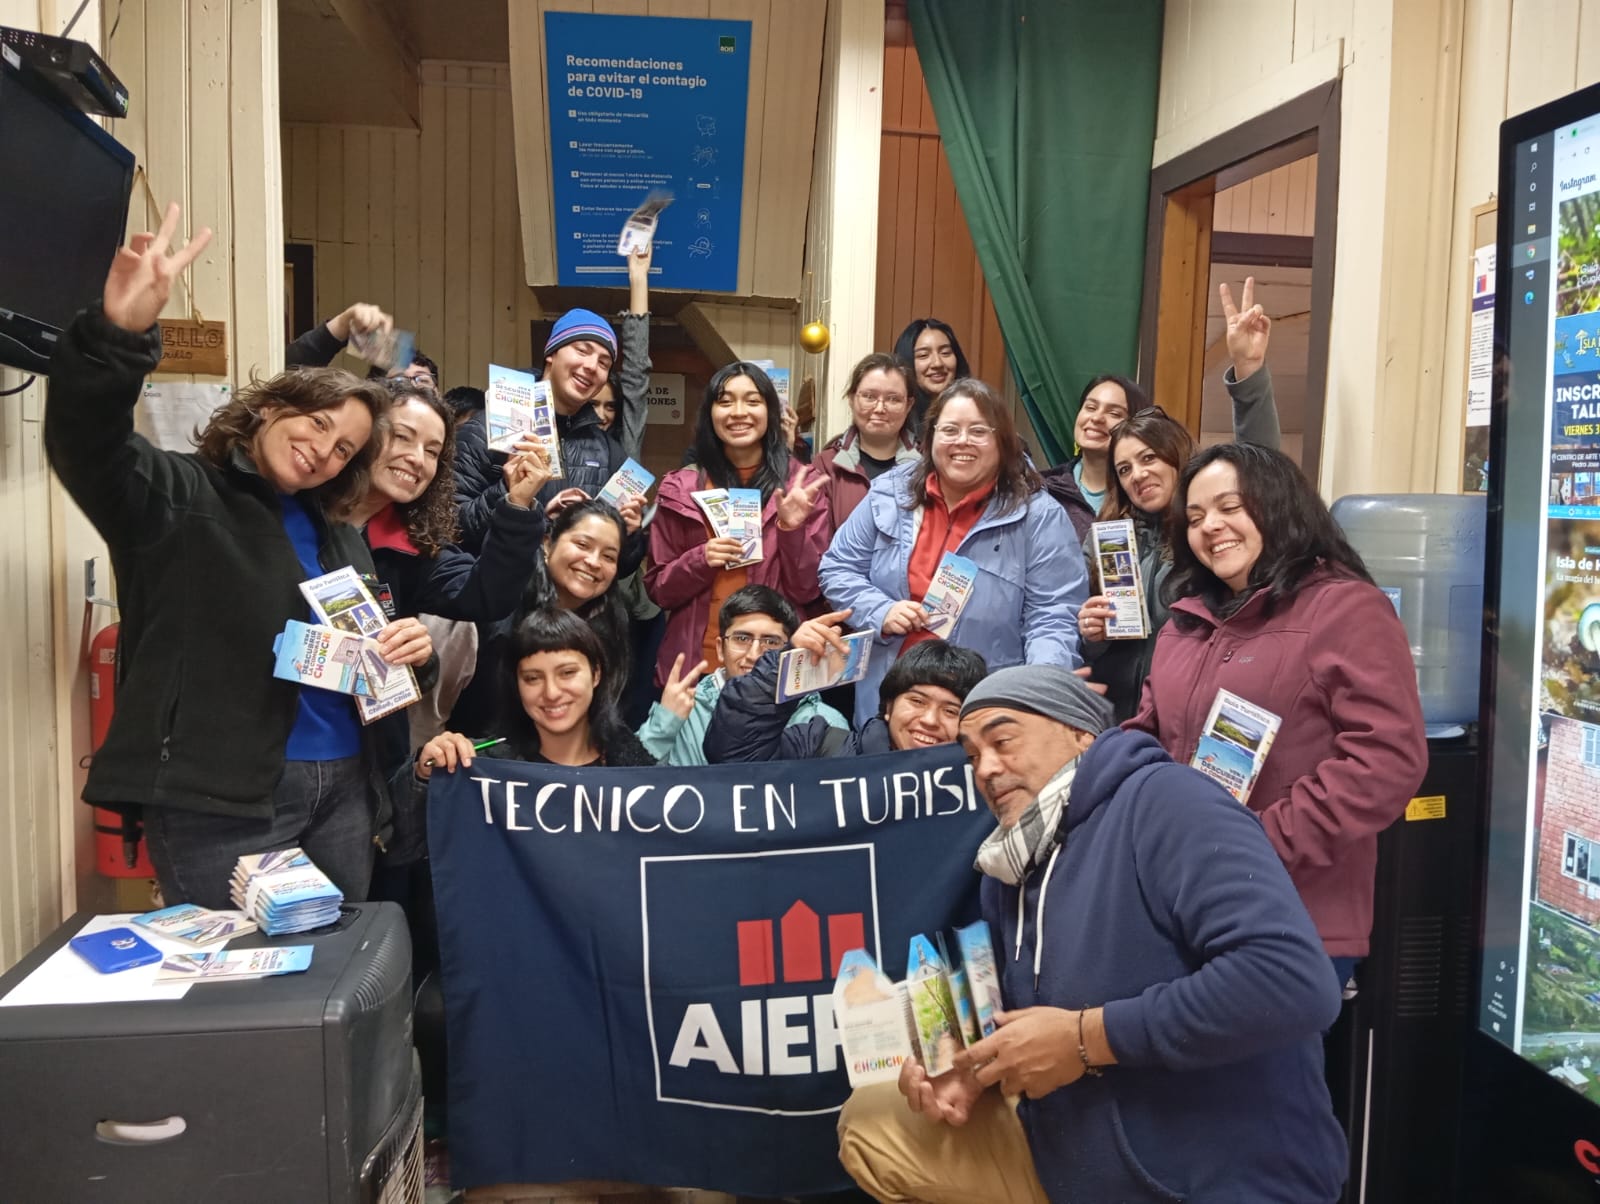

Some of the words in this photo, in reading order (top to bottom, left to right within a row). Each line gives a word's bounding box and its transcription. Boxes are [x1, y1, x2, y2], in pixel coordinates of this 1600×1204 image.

[566, 55, 683, 70] Recomendaciones
[568, 73, 596, 84] para
[598, 72, 636, 84] evitar
[639, 74, 649, 84] el
[652, 76, 706, 88] contagio
[568, 86, 583, 96] de
[586, 86, 642, 99] COVID-19
[1560, 174, 1596, 192] Instagram
[1564, 424, 1593, 436] VIERNES
[1556, 556, 1576, 569] Isla
[1578, 557, 1593, 571] de
[316, 632, 322, 641] DE
[302, 630, 317, 675] DESCUBRIR
[310, 641, 320, 667] COMUNA
[314, 632, 333, 679] CHONCHI
[308, 668, 314, 676] LA
[1201, 761, 1244, 785] DESCUBRIR
[470, 776, 705, 834] TECNICO
[732, 784, 796, 832] EN
